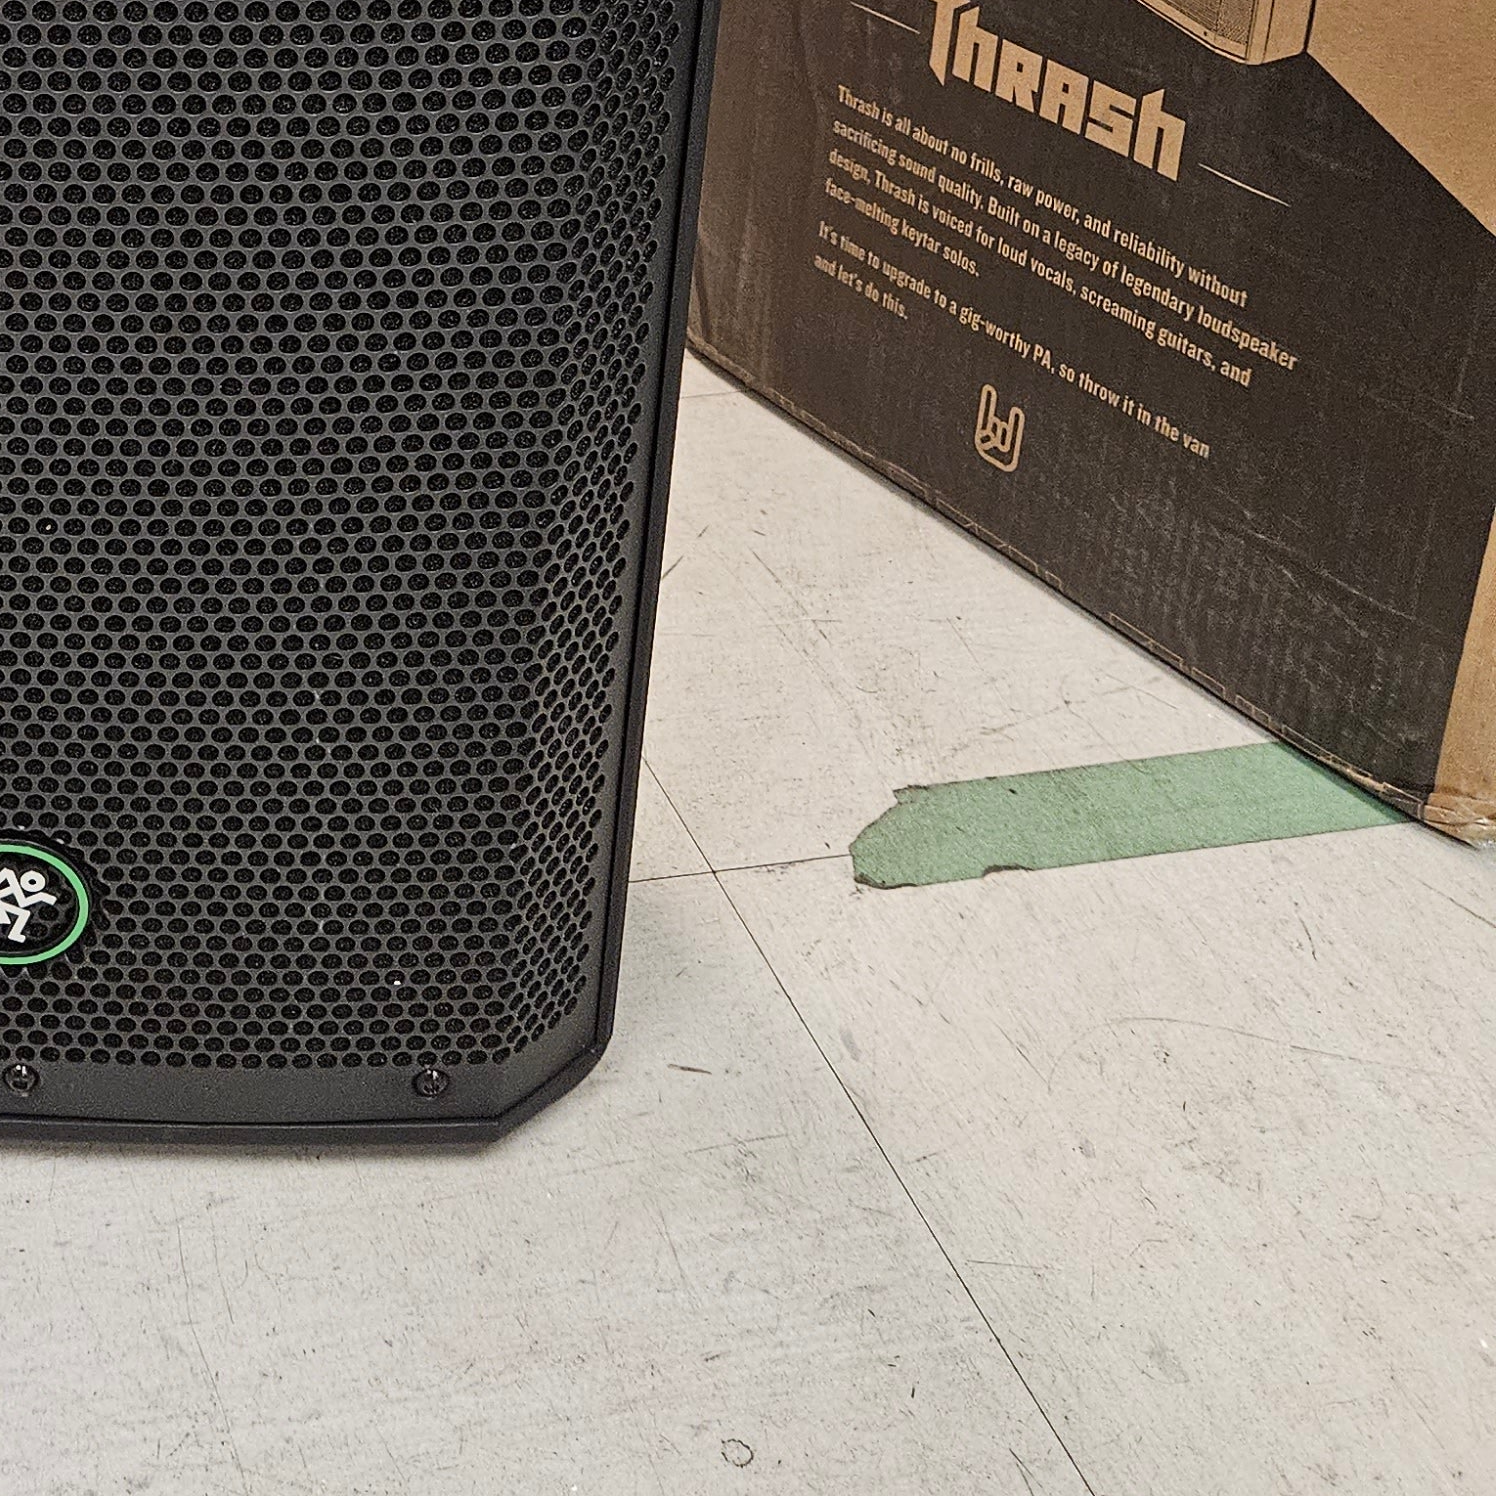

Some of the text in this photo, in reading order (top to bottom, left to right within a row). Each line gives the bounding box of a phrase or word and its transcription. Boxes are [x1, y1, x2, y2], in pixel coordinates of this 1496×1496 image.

[814, 254, 908, 319] and let's do this.
[824, 177, 980, 277] face-melting keytar solos.
[828, 149, 1252, 388] design, Thrash is voiced for loud vocals, screaming guitars, and
[832, 119, 1299, 371] sacrificing sound quality. Built on a legacy of legendary loudspeaker
[838, 84, 1248, 308] Thrash is all about no frills, raw power, and reliability without
[818, 220, 1210, 459] It's time to upgrade to a gig-worthy PA, so throw it in the van
